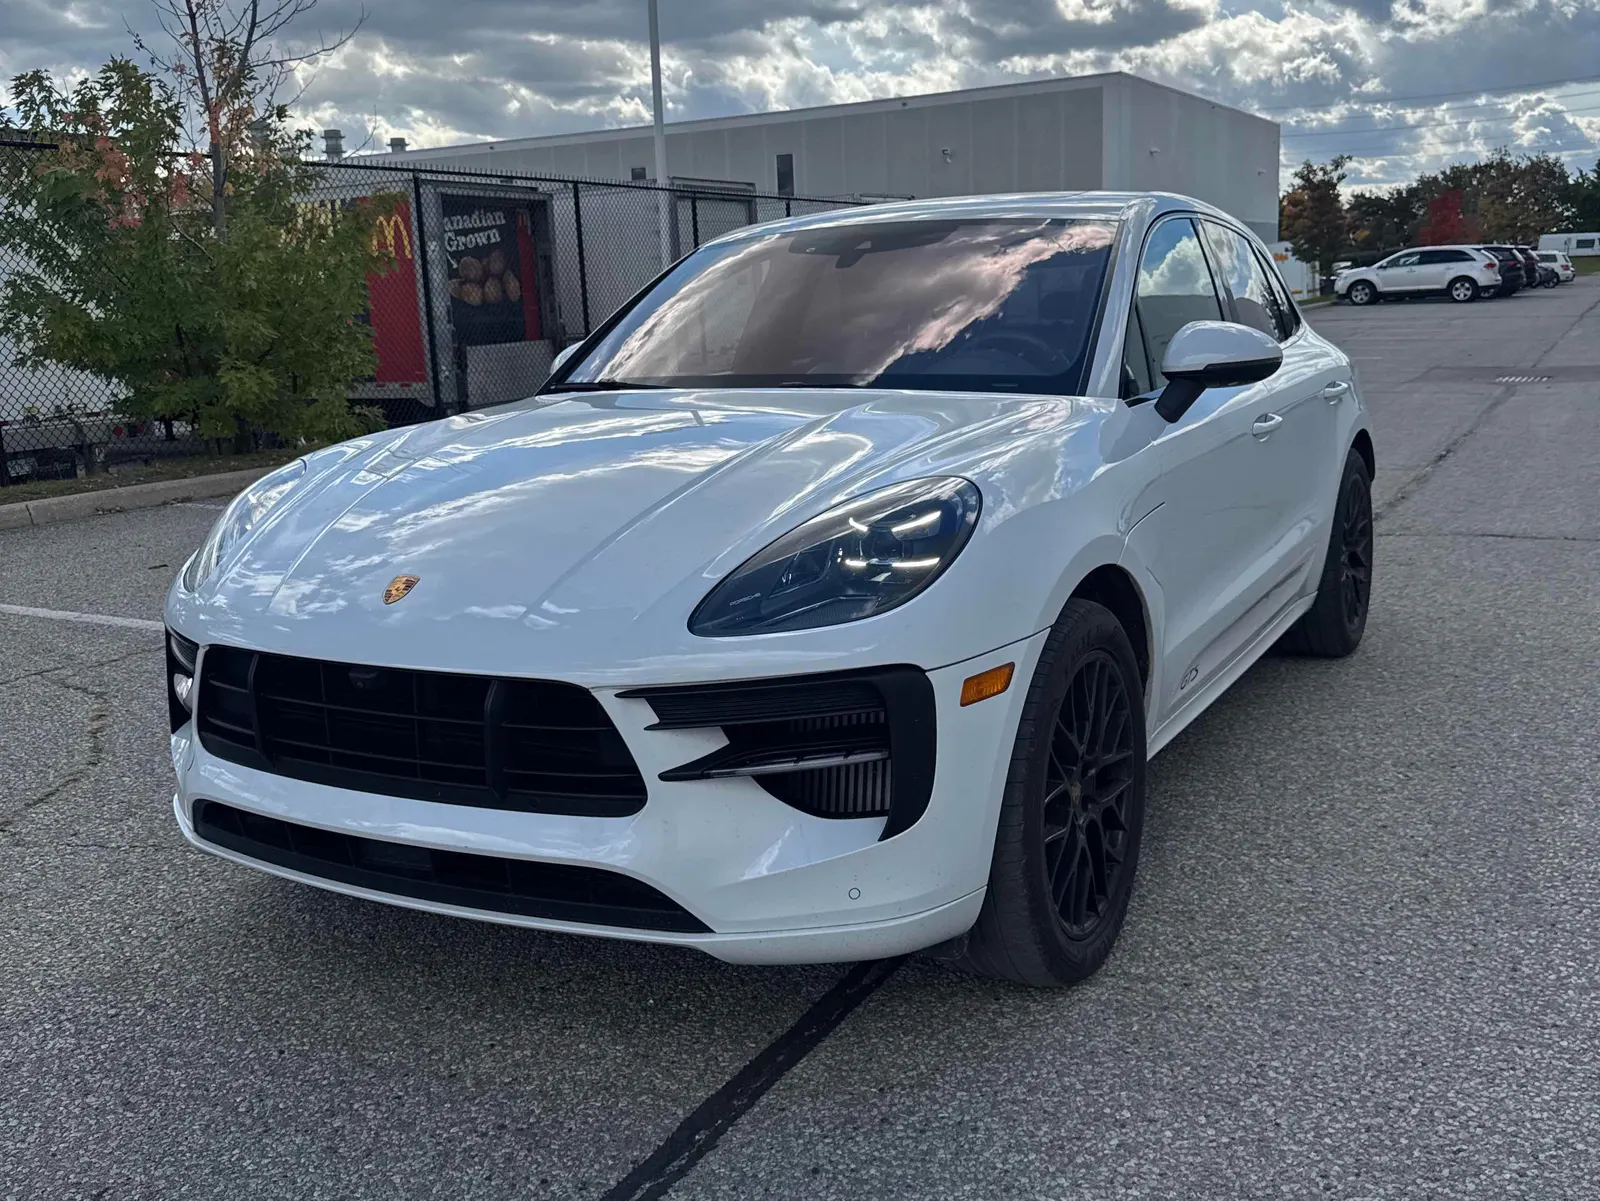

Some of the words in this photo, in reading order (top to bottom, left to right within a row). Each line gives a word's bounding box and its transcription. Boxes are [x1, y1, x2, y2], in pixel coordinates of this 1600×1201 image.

[443, 208, 506, 231] anadian
[444, 228, 501, 252] Grown
[1180, 664, 1199, 690] GTS
